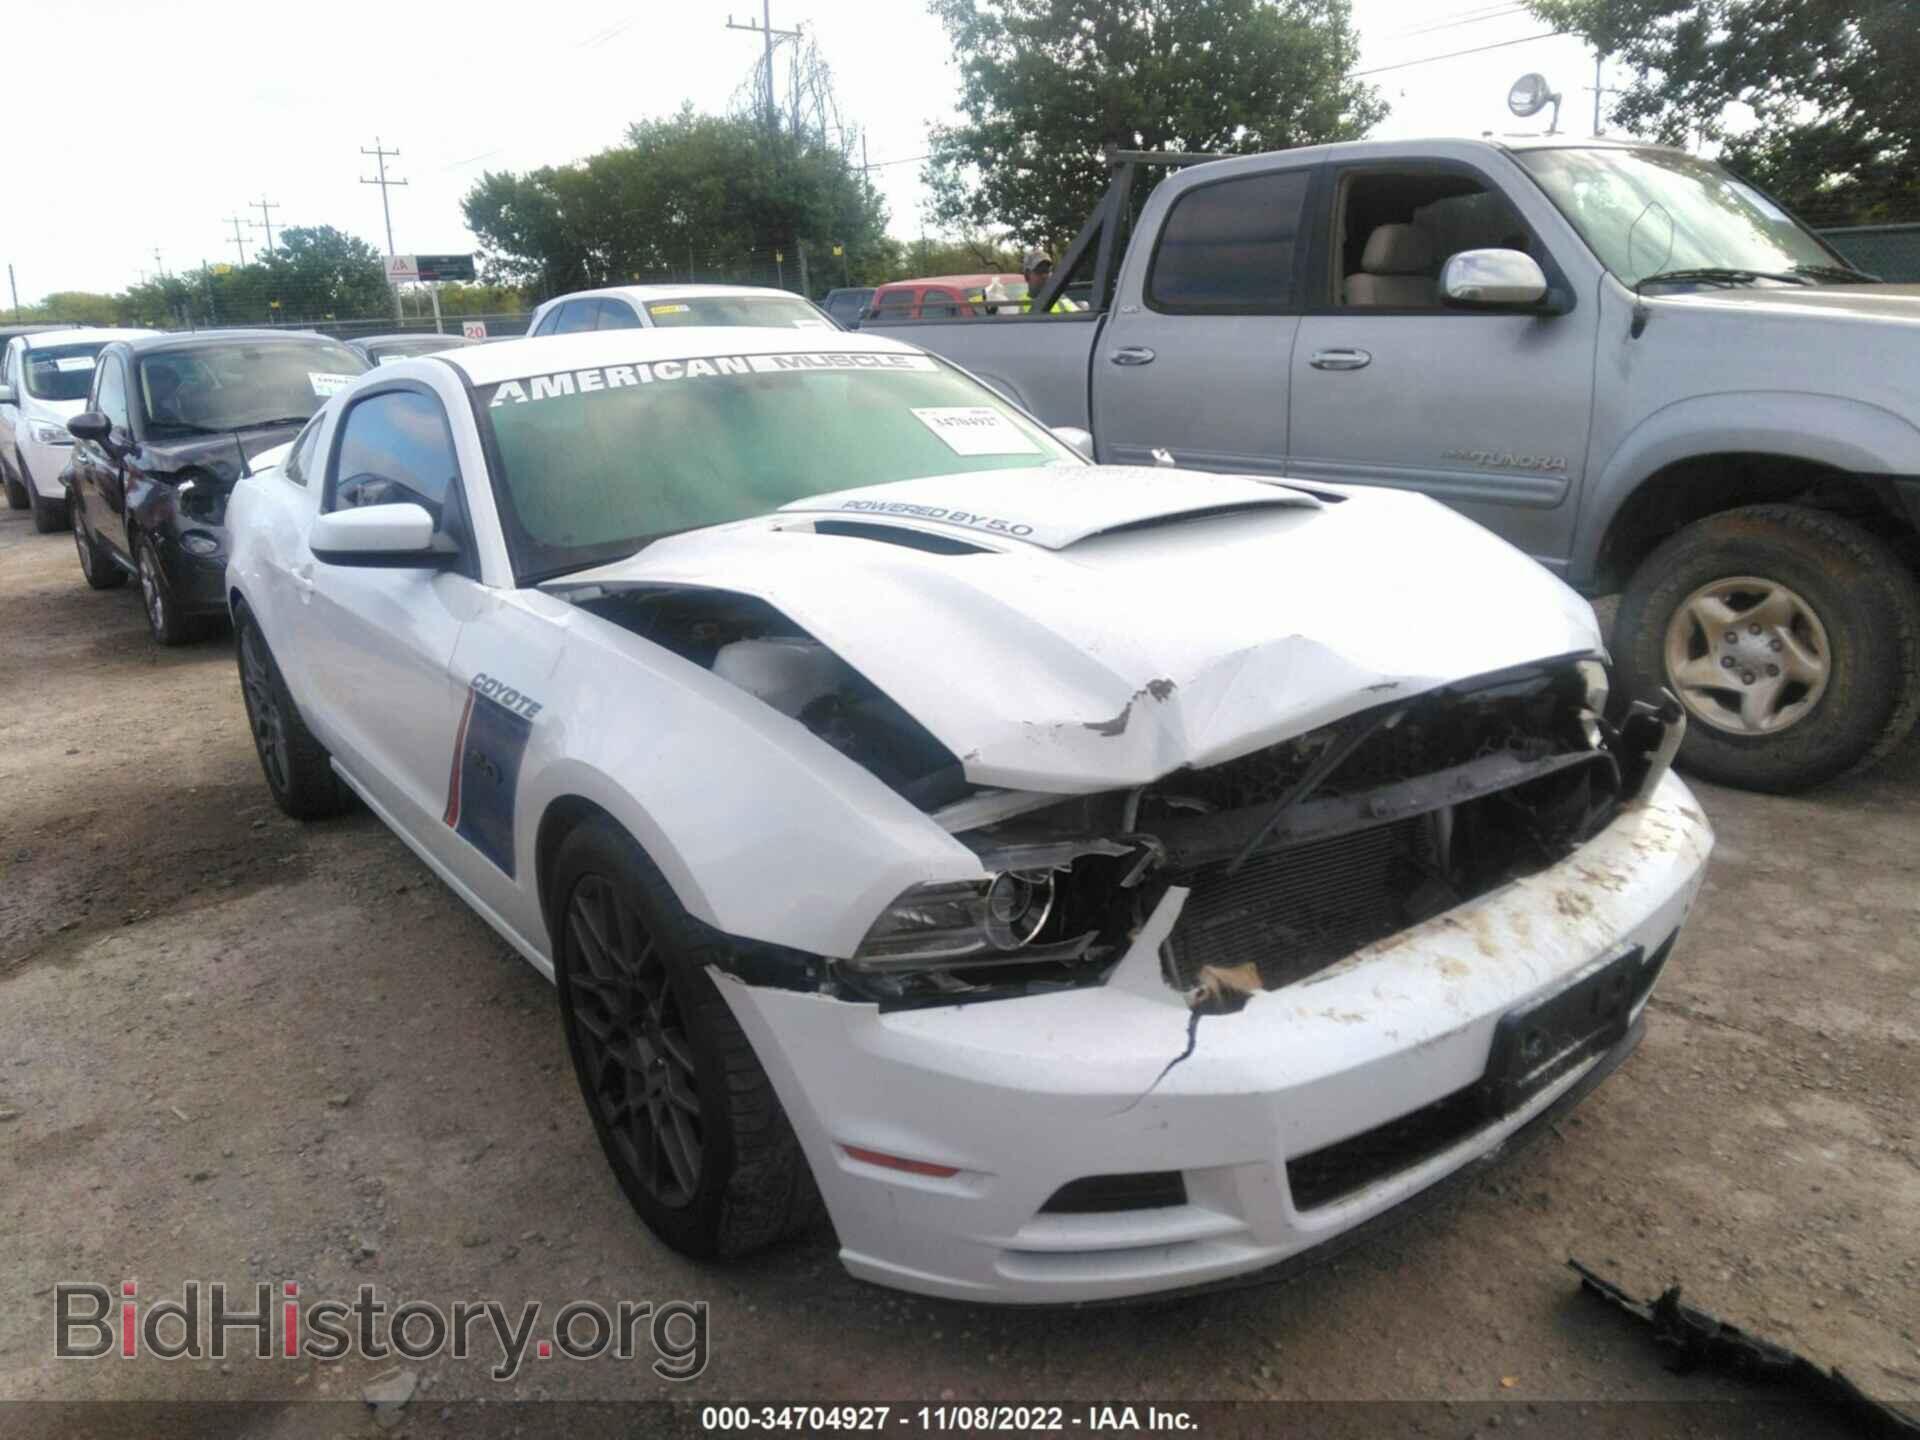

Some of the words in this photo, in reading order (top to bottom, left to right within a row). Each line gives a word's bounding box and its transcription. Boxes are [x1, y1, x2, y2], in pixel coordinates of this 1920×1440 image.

[464, 326, 484, 339] 20
[489, 356, 751, 407] AMERICAN
[771, 354, 914, 369] MUSCLE
[1471, 449, 1567, 472] TUNDRA
[841, 499, 949, 518] POWERED
[949, 510, 987, 526] BY
[986, 519, 1033, 537] 5.0
[471, 672, 543, 719] COYOTE
